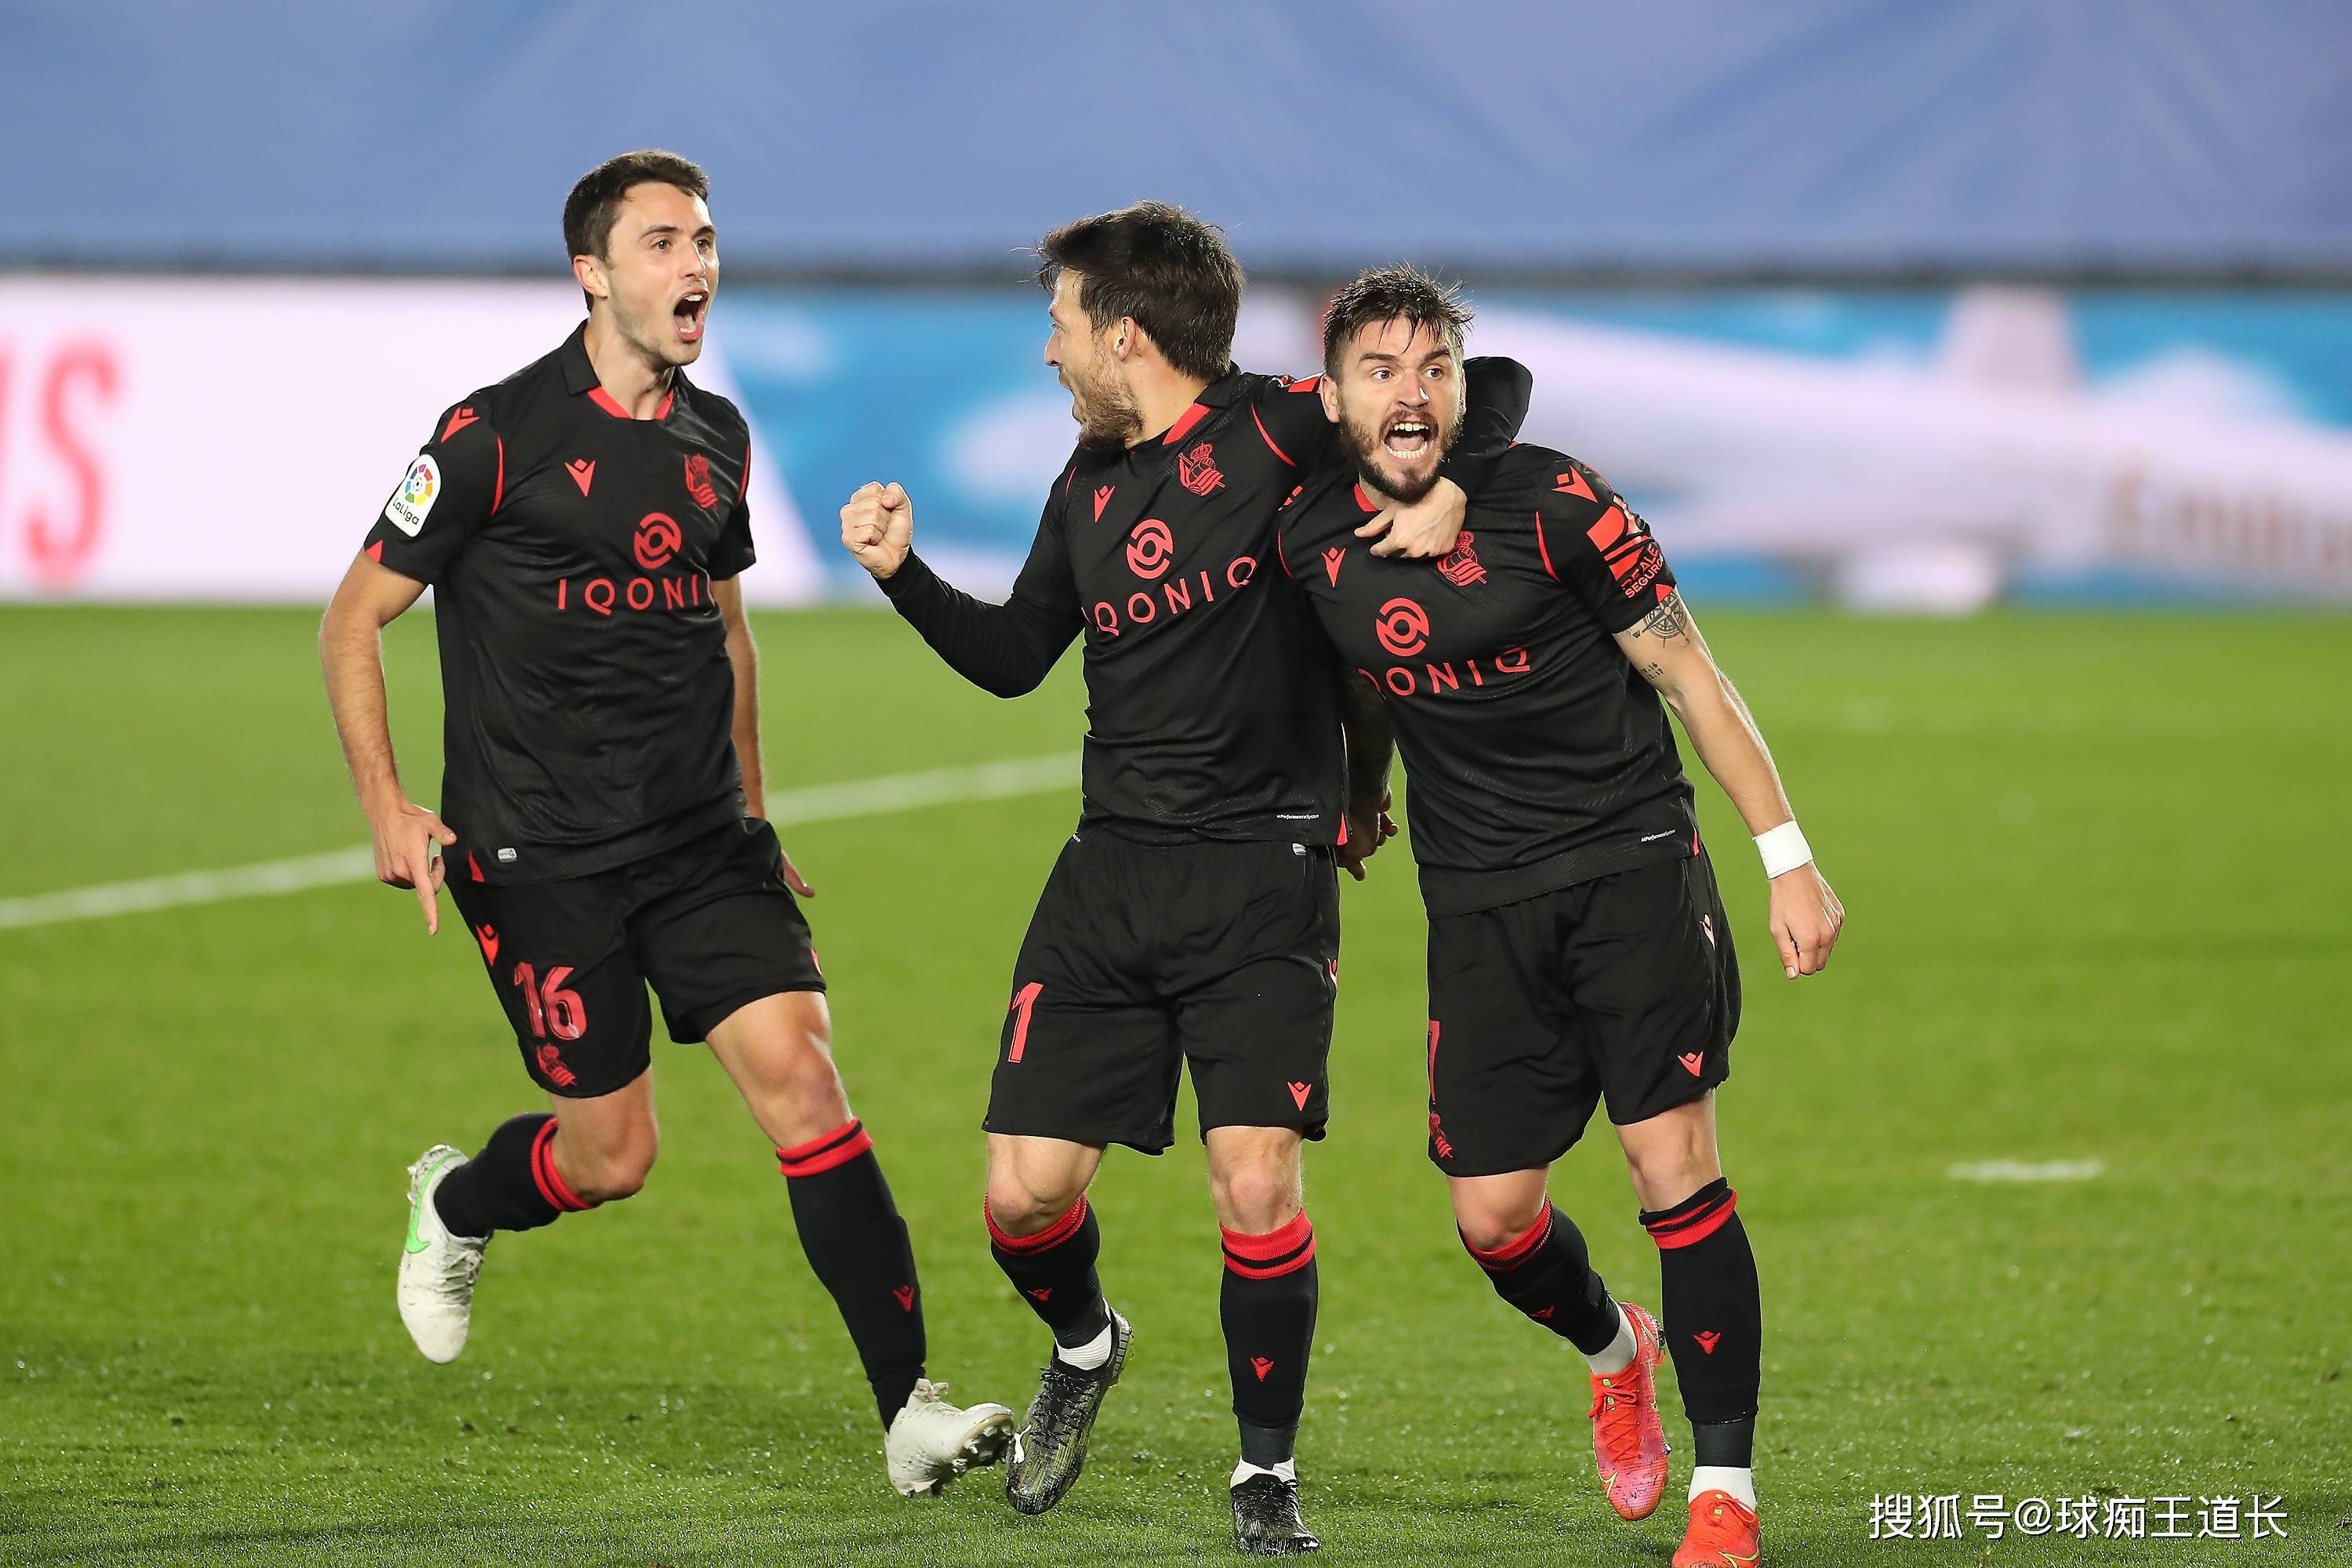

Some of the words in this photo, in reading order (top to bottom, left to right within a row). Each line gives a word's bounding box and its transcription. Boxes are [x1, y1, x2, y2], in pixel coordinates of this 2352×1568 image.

[393, 497, 419, 524] LaLiga
[557, 574, 715, 615] IQONI
[1081, 557, 1257, 636] QONIQ
[514, 961, 588, 1040] 16
